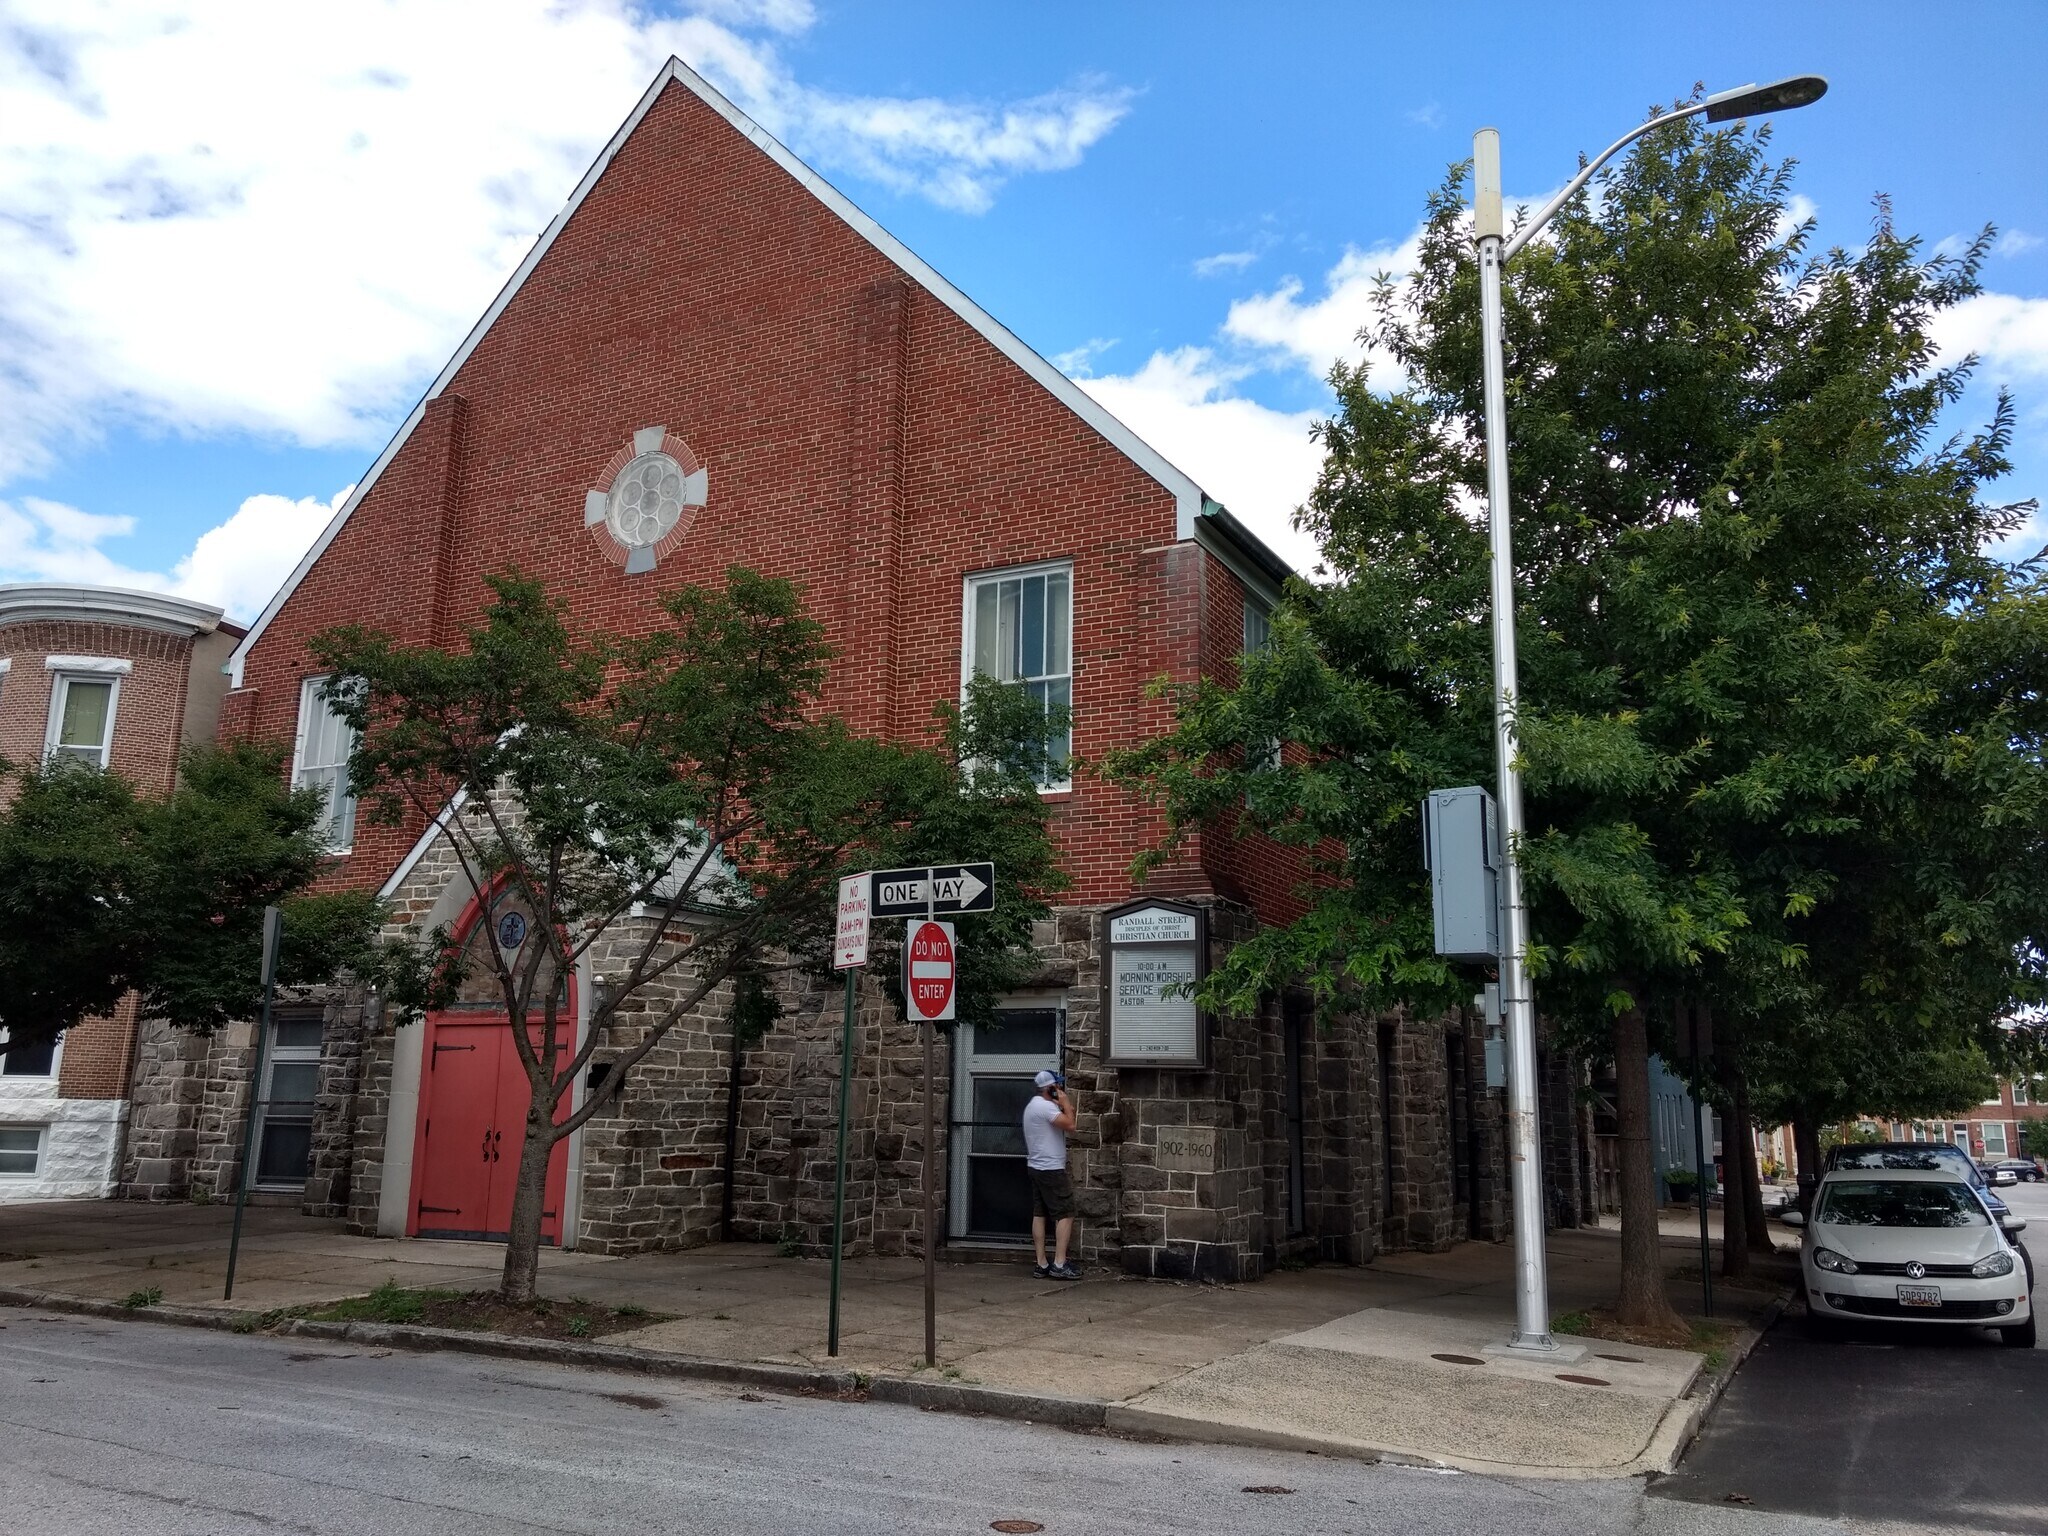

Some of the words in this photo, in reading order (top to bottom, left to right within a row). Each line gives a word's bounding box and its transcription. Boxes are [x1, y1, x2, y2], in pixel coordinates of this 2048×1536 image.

[849, 885, 858, 899] NO
[883, 883, 918, 902] ONE
[840, 899, 866, 916] PARKING
[1118, 917, 1154, 926] RANDALL
[1158, 916, 1188, 924] STREET
[1115, 932, 1156, 940] CHRISTIAN
[1157, 931, 1190, 939] CHURCH
[916, 941, 927, 956] DO
[932, 942, 947, 956] NOT
[1120, 972, 1154, 983] MORNING
[1157, 972, 1191, 982] WORSHIP
[919, 984, 945, 999] ENTER
[1120, 985, 1153, 995] SERVICE
[1120, 998, 1144, 1006] PASTOR
[1160, 1141, 1212, 1157] 1902-1960
[1900, 1291, 1938, 1302] 5DP9782
